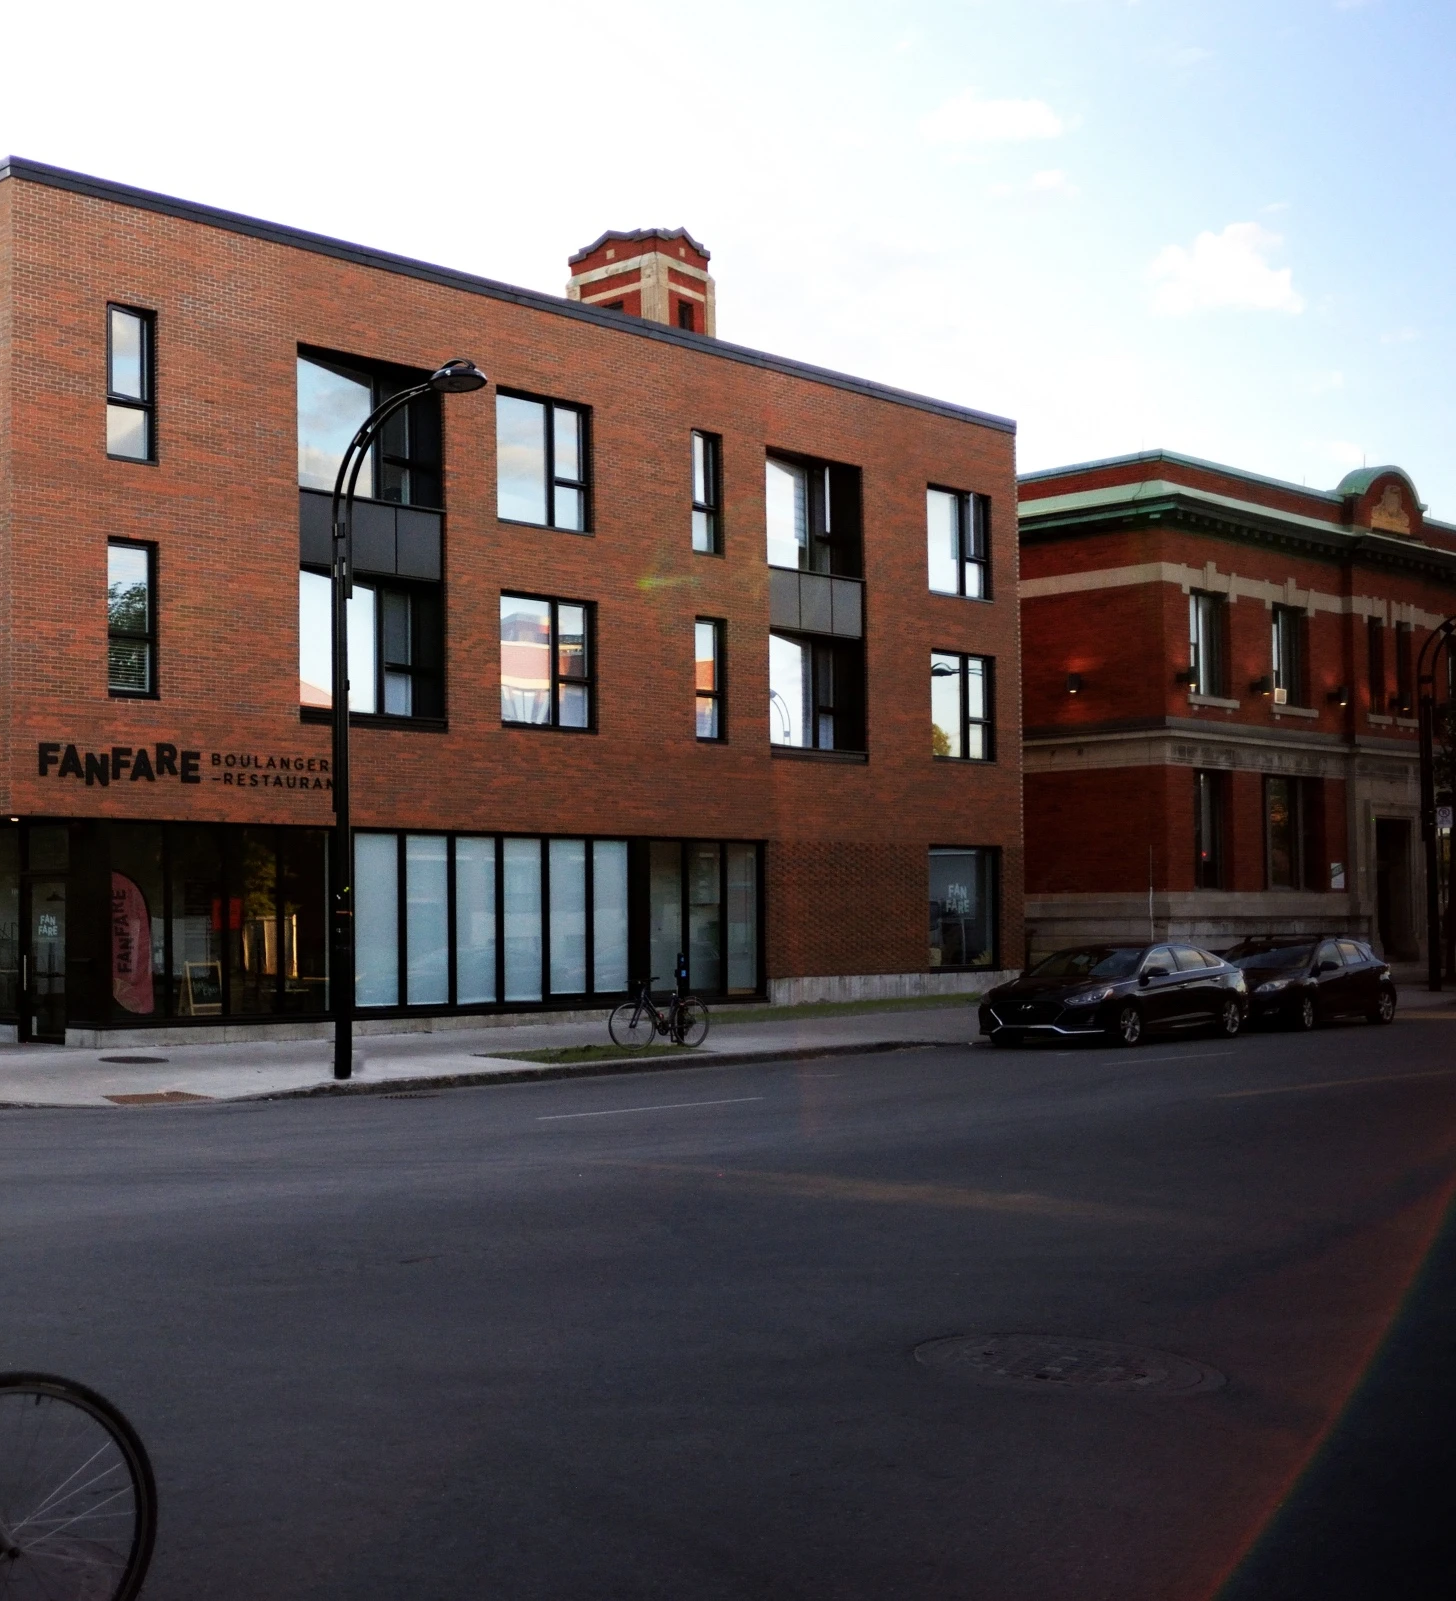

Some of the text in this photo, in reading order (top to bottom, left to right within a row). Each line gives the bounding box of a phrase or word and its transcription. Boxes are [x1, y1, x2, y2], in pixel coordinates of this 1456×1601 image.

[38, 742, 201, 787] FANFARE
[211, 752, 332, 772] BOULANGER
[212, 772, 333, 790] -RESTAURAN
[948, 883, 967, 899] FAN
[946, 898, 969, 913] FARE
[40, 914, 56, 926] FAN
[38, 924, 58, 937] FARE
[111, 888, 134, 974] FANFARE
